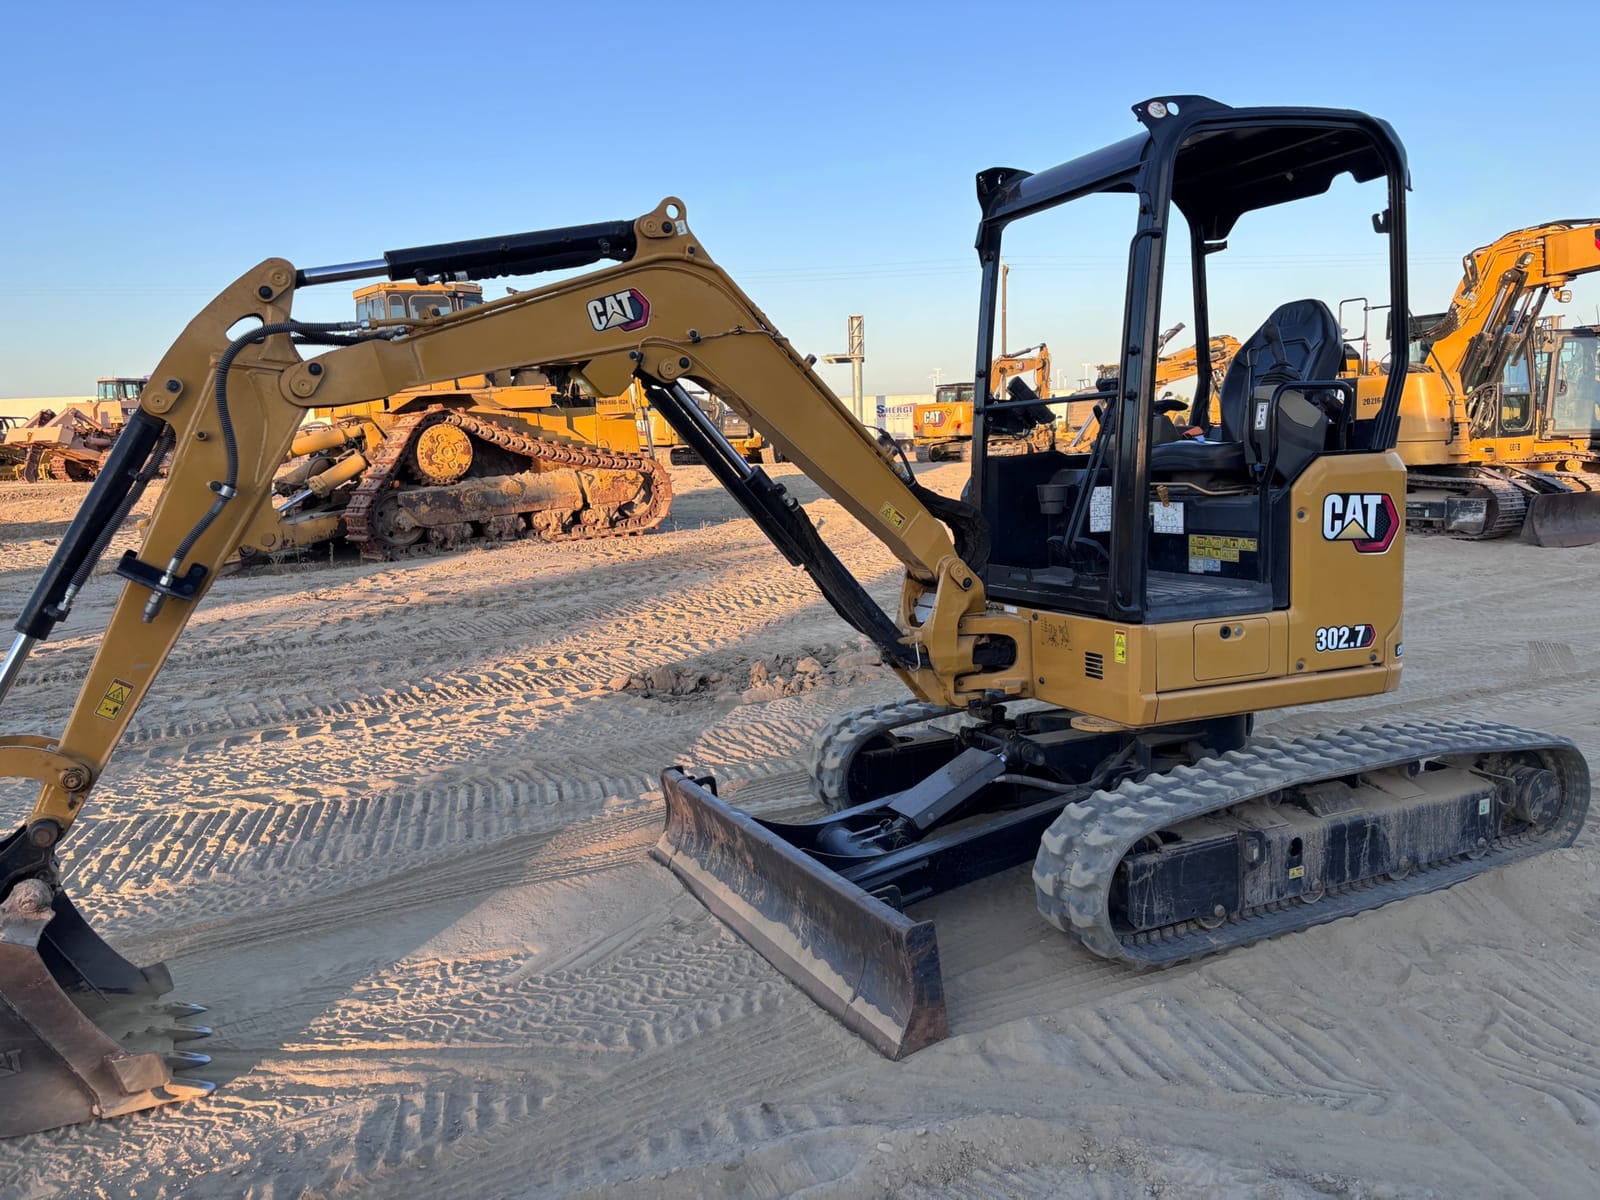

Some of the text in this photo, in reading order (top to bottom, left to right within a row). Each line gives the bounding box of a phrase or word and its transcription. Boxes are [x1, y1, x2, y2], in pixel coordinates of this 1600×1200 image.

[588, 291, 634, 331] CAT
[923, 410, 940, 424] CAT
[1323, 494, 1382, 540] CAT
[1316, 625, 1365, 651] 302.7
